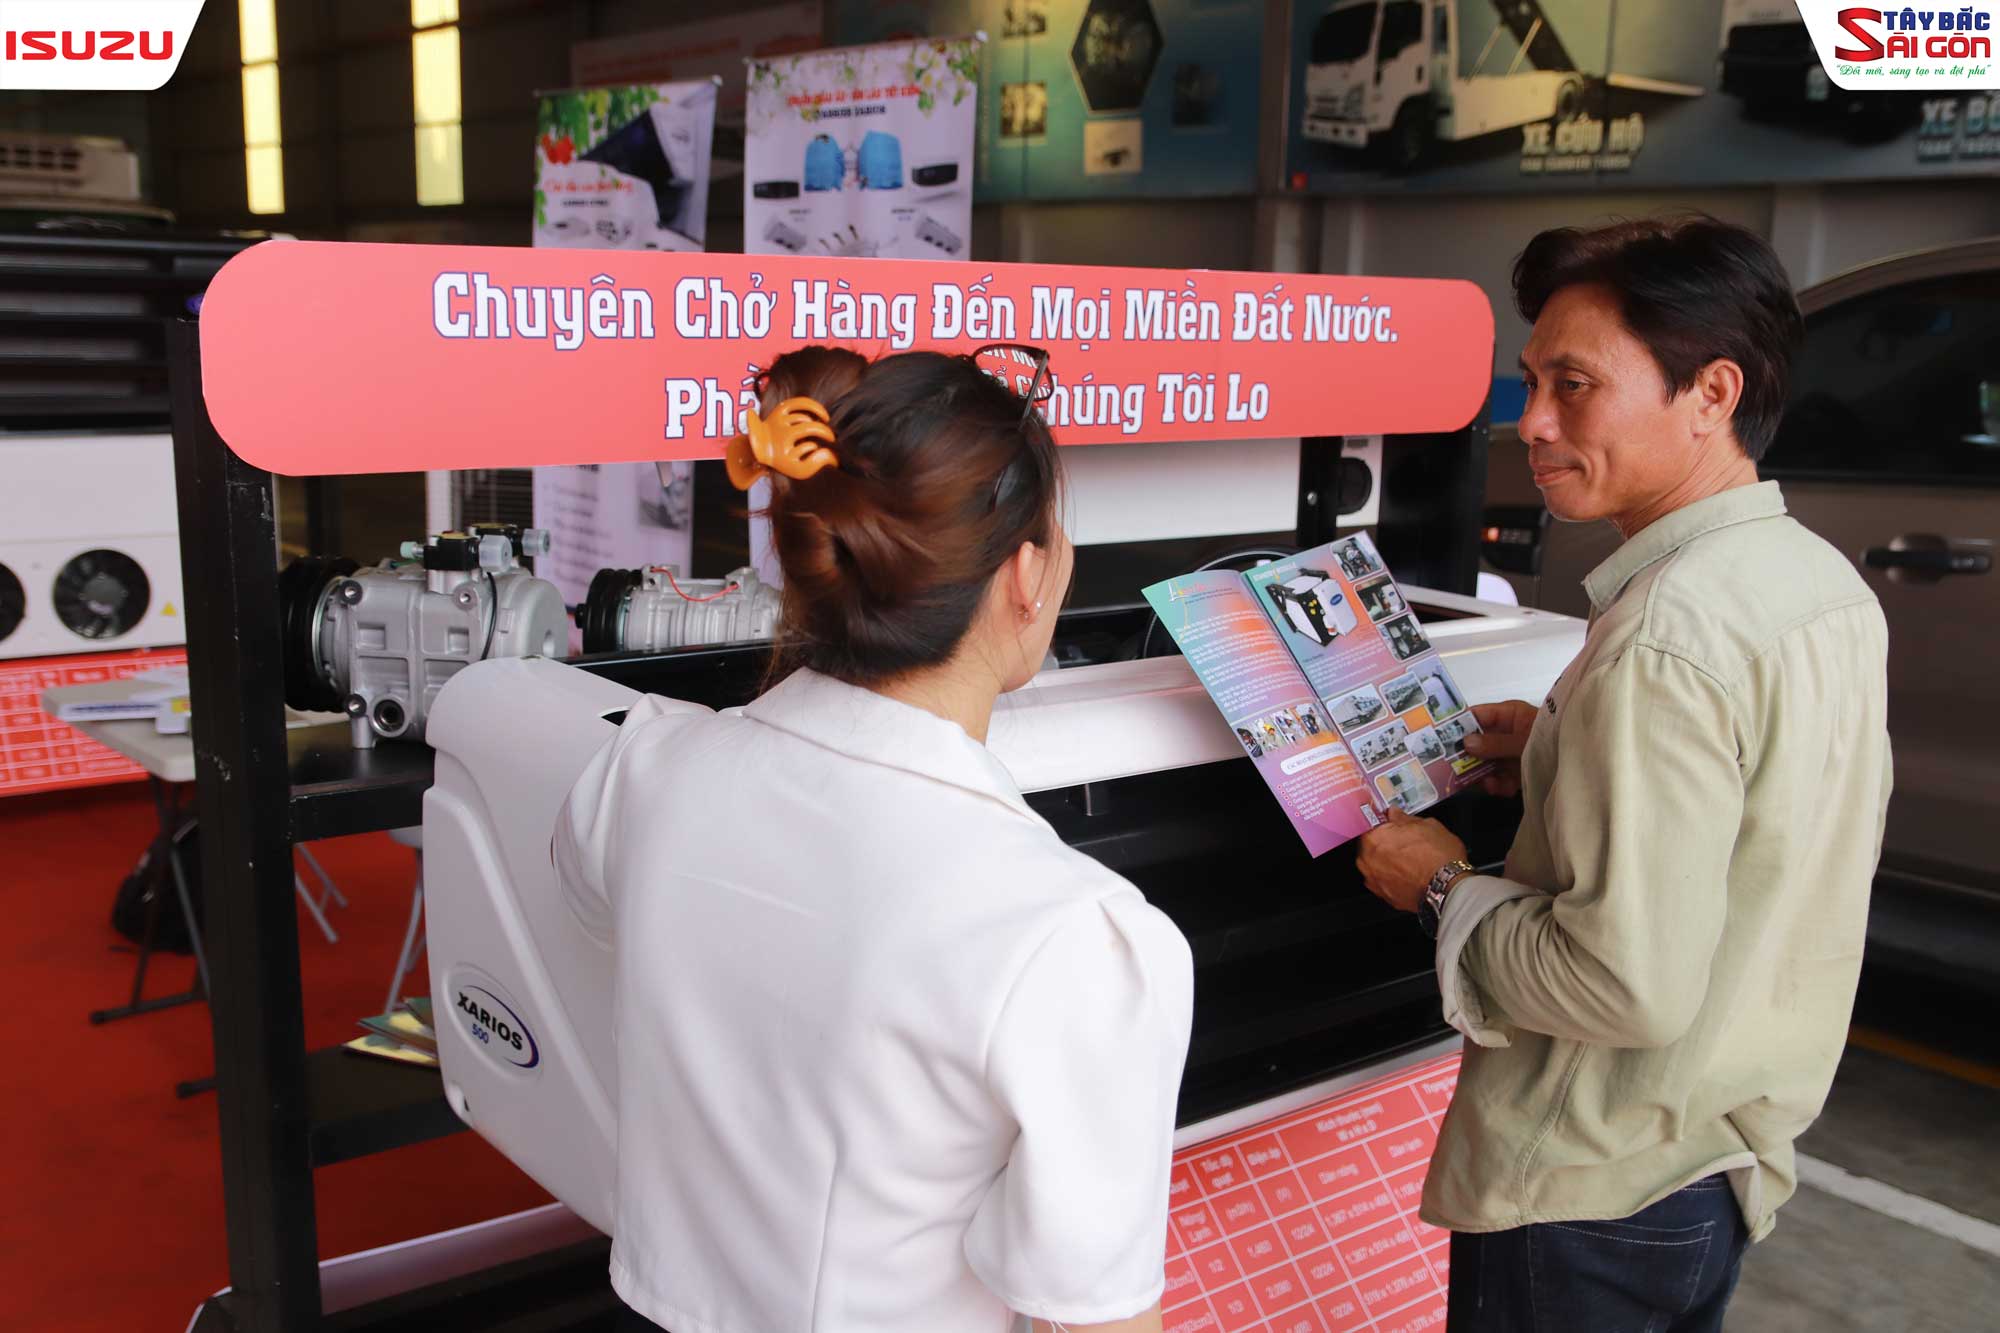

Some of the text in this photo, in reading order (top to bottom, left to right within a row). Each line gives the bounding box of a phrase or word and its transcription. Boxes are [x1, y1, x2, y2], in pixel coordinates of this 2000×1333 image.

[433, 272, 1399, 351] Chuyên Chở Hàng Đến Mọi Miền Đất Nước.
[1156, 373, 1216, 424] Tôi
[1225, 372, 1270, 422] Lo
[457, 991, 523, 1051] XARIOS
[472, 1023, 489, 1044] 500
